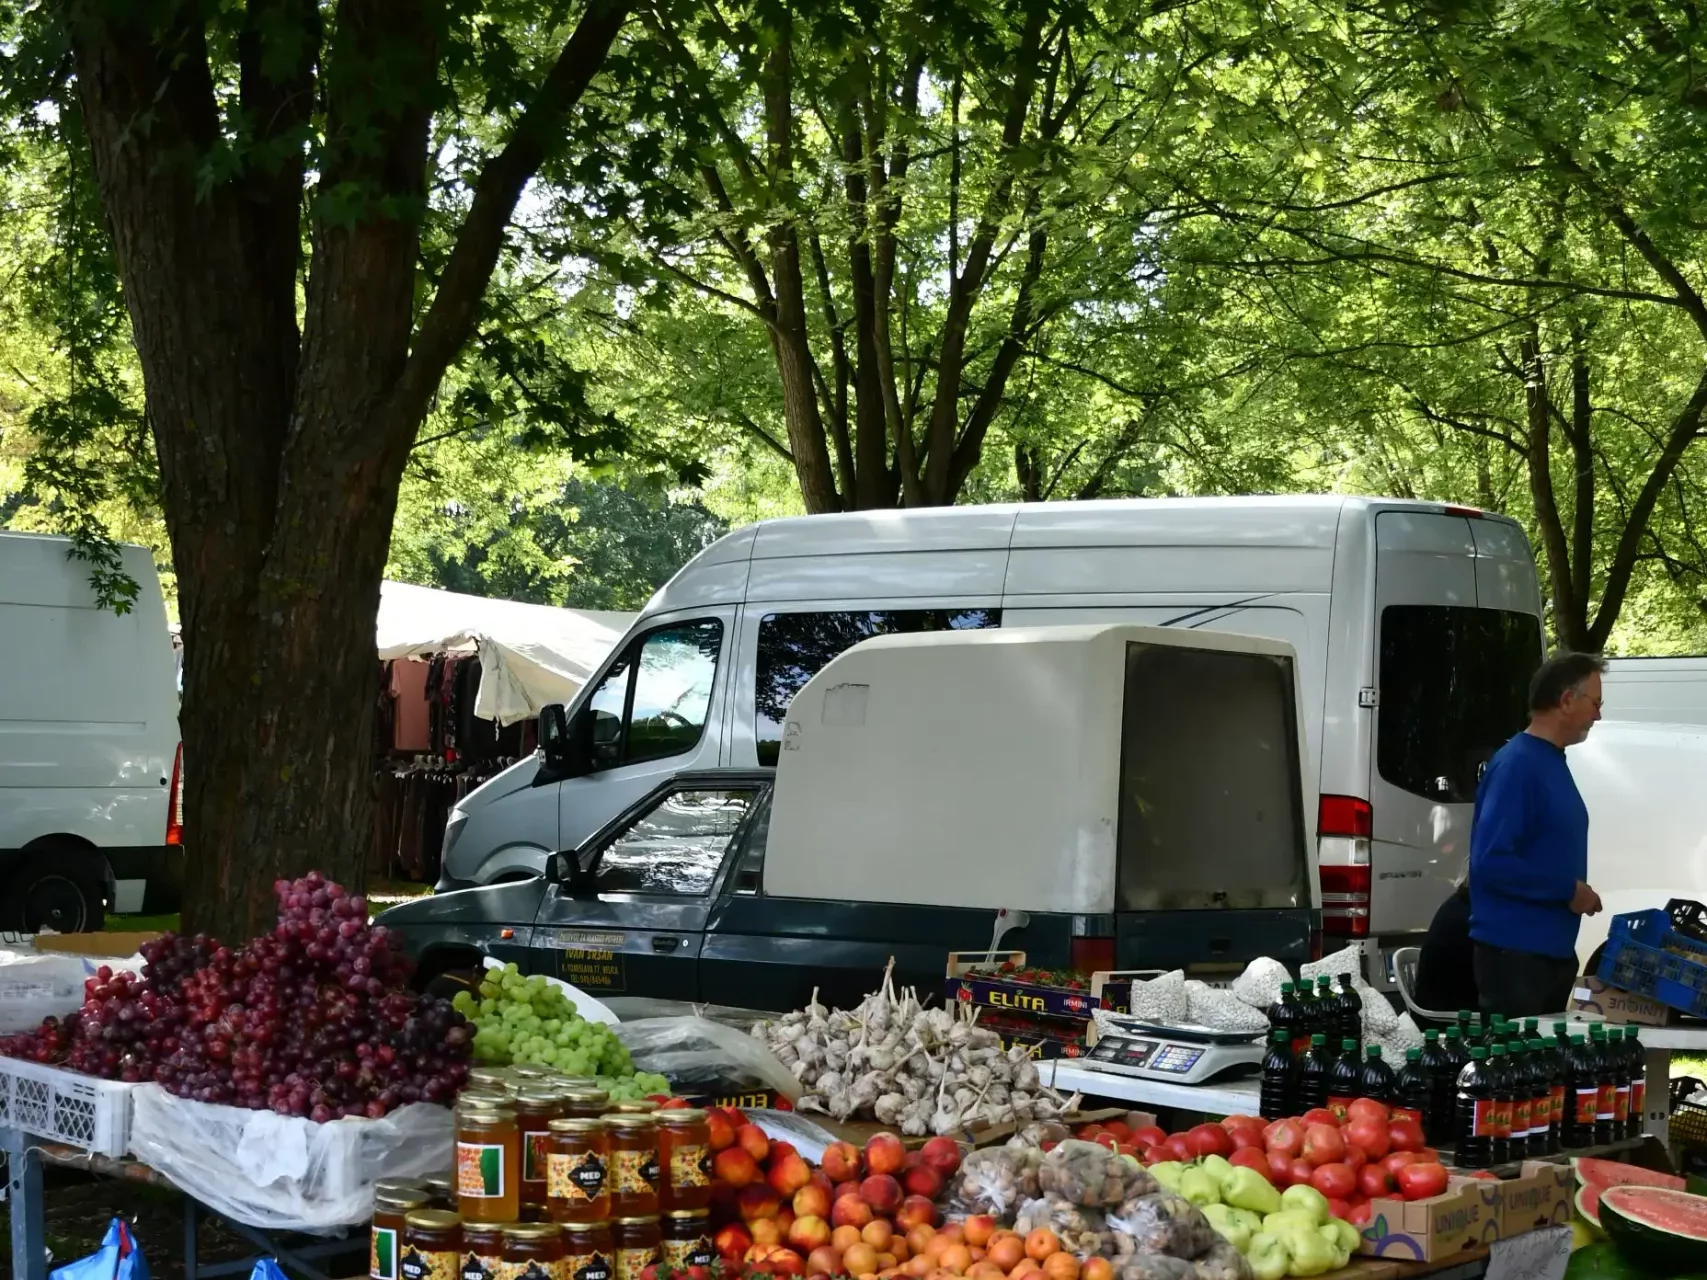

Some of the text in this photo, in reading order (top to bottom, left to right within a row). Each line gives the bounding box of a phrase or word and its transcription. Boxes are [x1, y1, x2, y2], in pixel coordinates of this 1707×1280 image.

[565, 948, 584, 960] IVAN
[989, 990, 1045, 1012] ELITA
[1063, 998, 1088, 1010] IRMINI
[580, 1171, 601, 1181] MED
[1435, 1203, 1479, 1234] UNIQUE
[403, 1264, 421, 1275] MED
[464, 1271, 483, 1280] MED
[586, 1271, 606, 1280] MED
